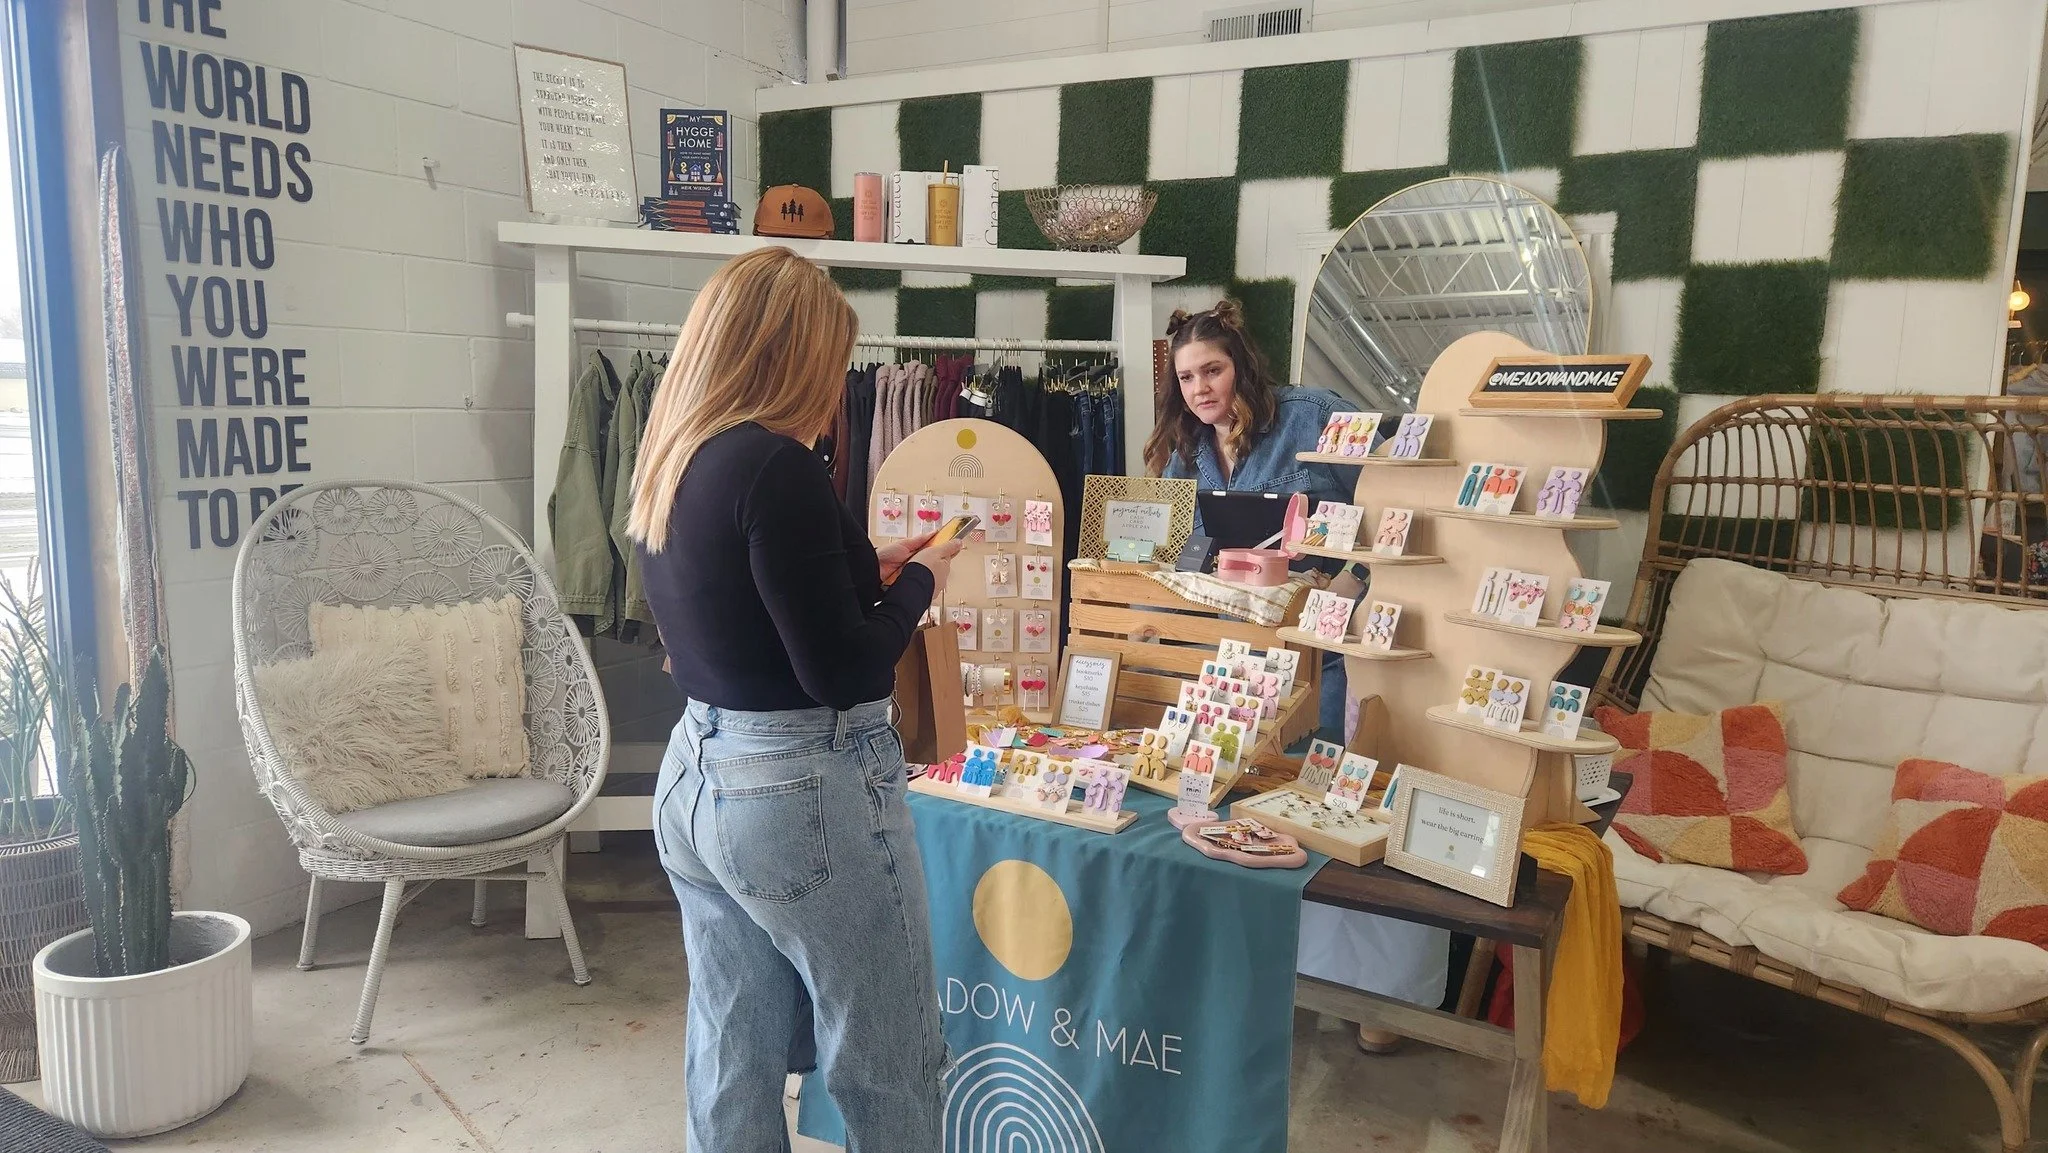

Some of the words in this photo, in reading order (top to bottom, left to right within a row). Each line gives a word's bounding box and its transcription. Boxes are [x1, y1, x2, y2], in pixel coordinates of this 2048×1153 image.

[139, 41, 311, 135] WORLD
[533, 72, 544, 82] THE
[569, 77, 575, 86] IS
[577, 79, 585, 88] TO
[538, 107, 552, 117] WITH
[554, 109, 575, 120] PEOPLE
[539, 121, 554, 132] YOUR
[555, 124, 574, 135] HEART
[676, 127, 714, 137] HYGGE
[541, 139, 548, 148] IT
[549, 140, 555, 149] IS
[679, 138, 711, 148] HOME
[152, 120, 313, 203] NEEDS
[543, 155, 556, 164] AND
[557, 156, 571, 166] ONLY
[985, 169, 999, 245] Created
[157, 197, 275, 270] WHO
[165, 274, 268, 340] YOU
[171, 344, 310, 407] WERE
[1489, 371, 1624, 386] @MEADOWANDMAE
[176, 415, 311, 478] MADE
[177, 488, 239, 550] TO
[1113, 506, 1141, 517] payment
[1332, 798, 1348, 809] $20
[1438, 806, 1449, 816] life
[1421, 818, 1437, 828] wear
[1437, 822, 1448, 832] the
[1449, 826, 1459, 837] big
[1050, 1007, 1079, 1050] &
[1096, 1019, 1182, 1075] MAE
